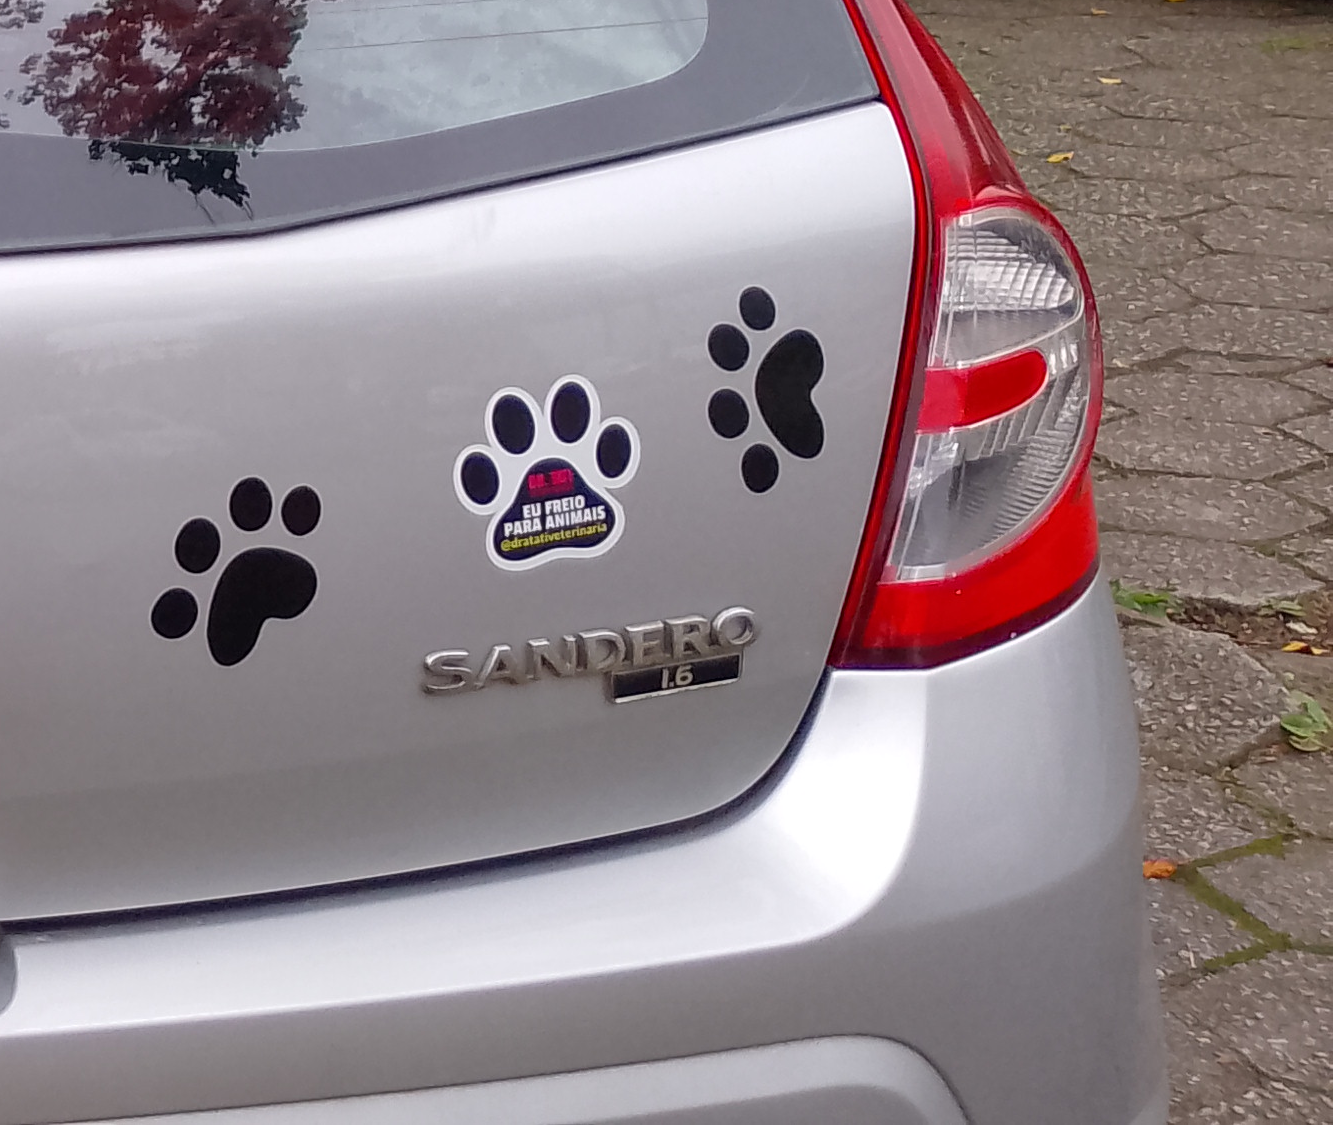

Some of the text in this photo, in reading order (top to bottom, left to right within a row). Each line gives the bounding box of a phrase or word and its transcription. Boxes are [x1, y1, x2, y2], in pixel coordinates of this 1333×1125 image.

[503, 505, 606, 537] PARA ANIMAIS
[522, 495, 586, 519] EU FREIO
[422, 605, 757, 695] SANDERO
[660, 664, 695, 690] 1.6
